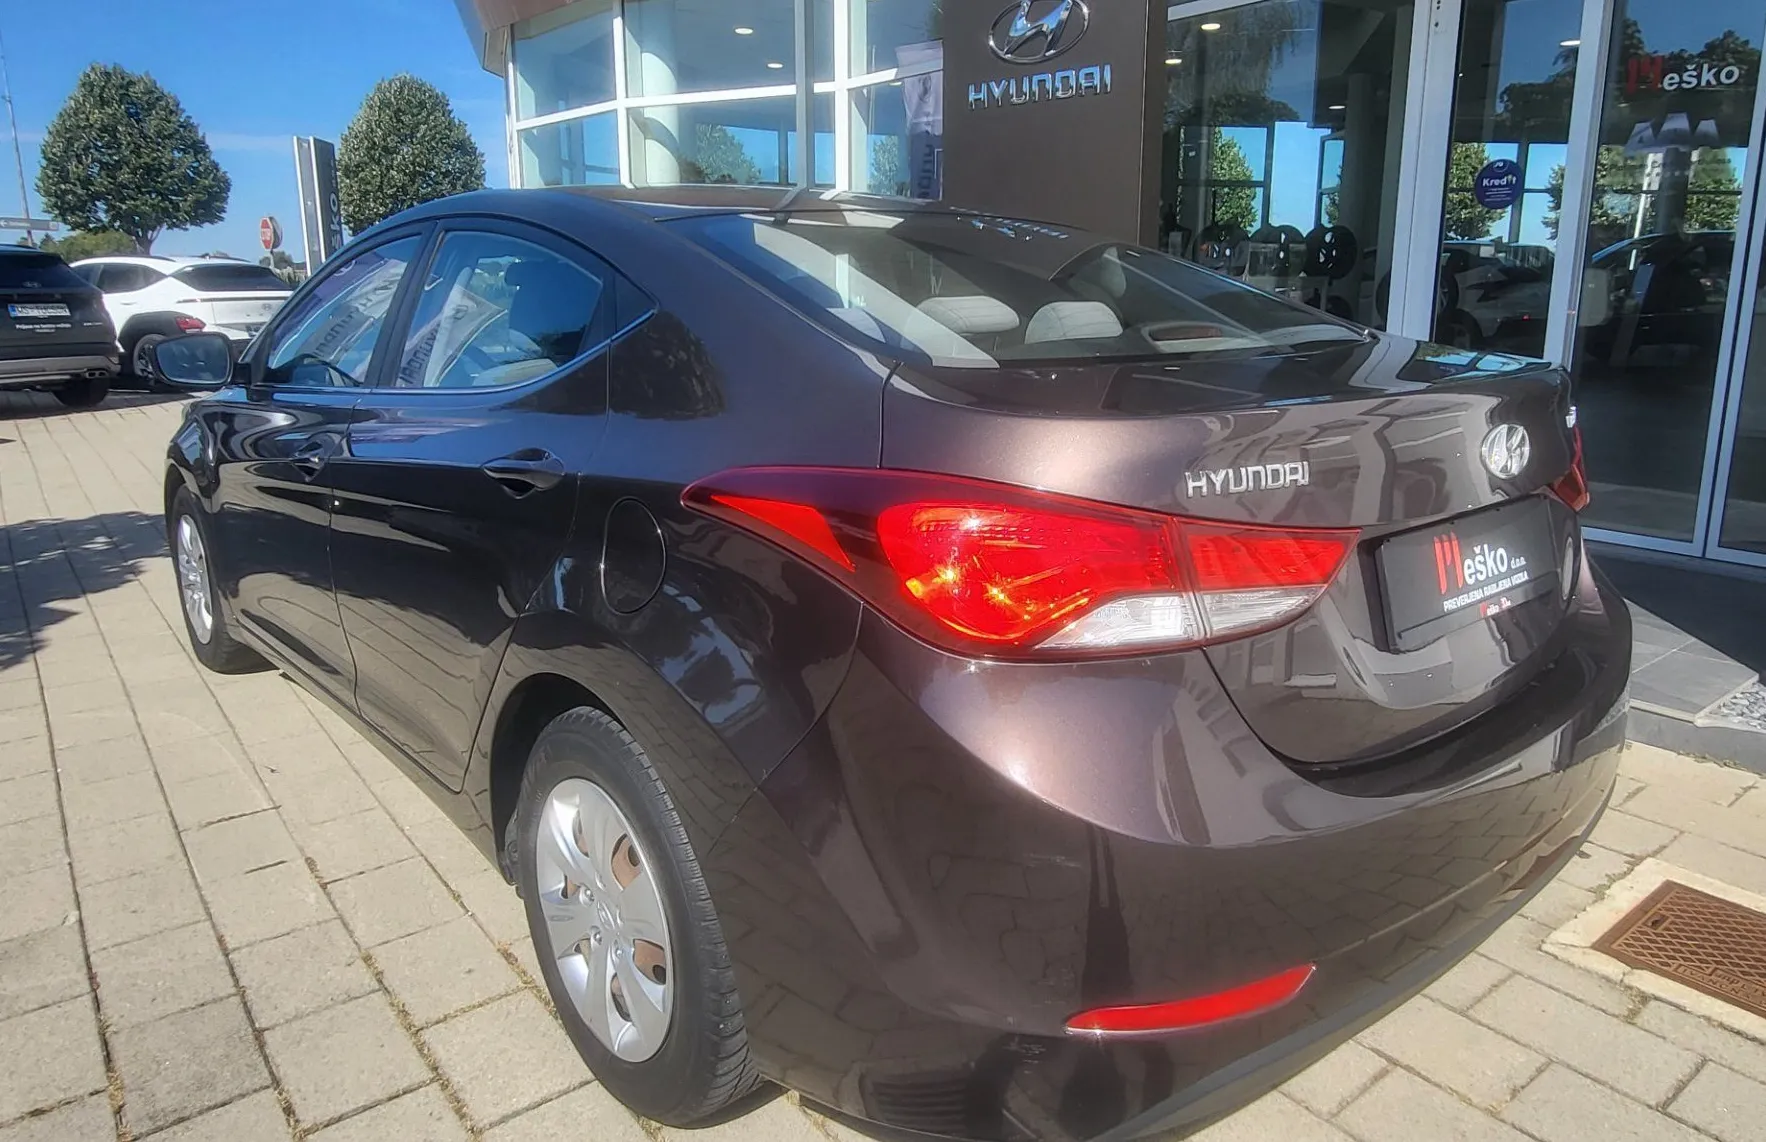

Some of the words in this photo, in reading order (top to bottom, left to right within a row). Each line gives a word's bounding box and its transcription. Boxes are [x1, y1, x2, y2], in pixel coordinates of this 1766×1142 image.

[968, 64, 1112, 109] HYUNDAI
[1628, 56, 1740, 94] Meško
[1482, 174, 1517, 187] Kredit
[1184, 461, 1309, 498] HYUNDAI
[1433, 531, 1508, 595] Meško
